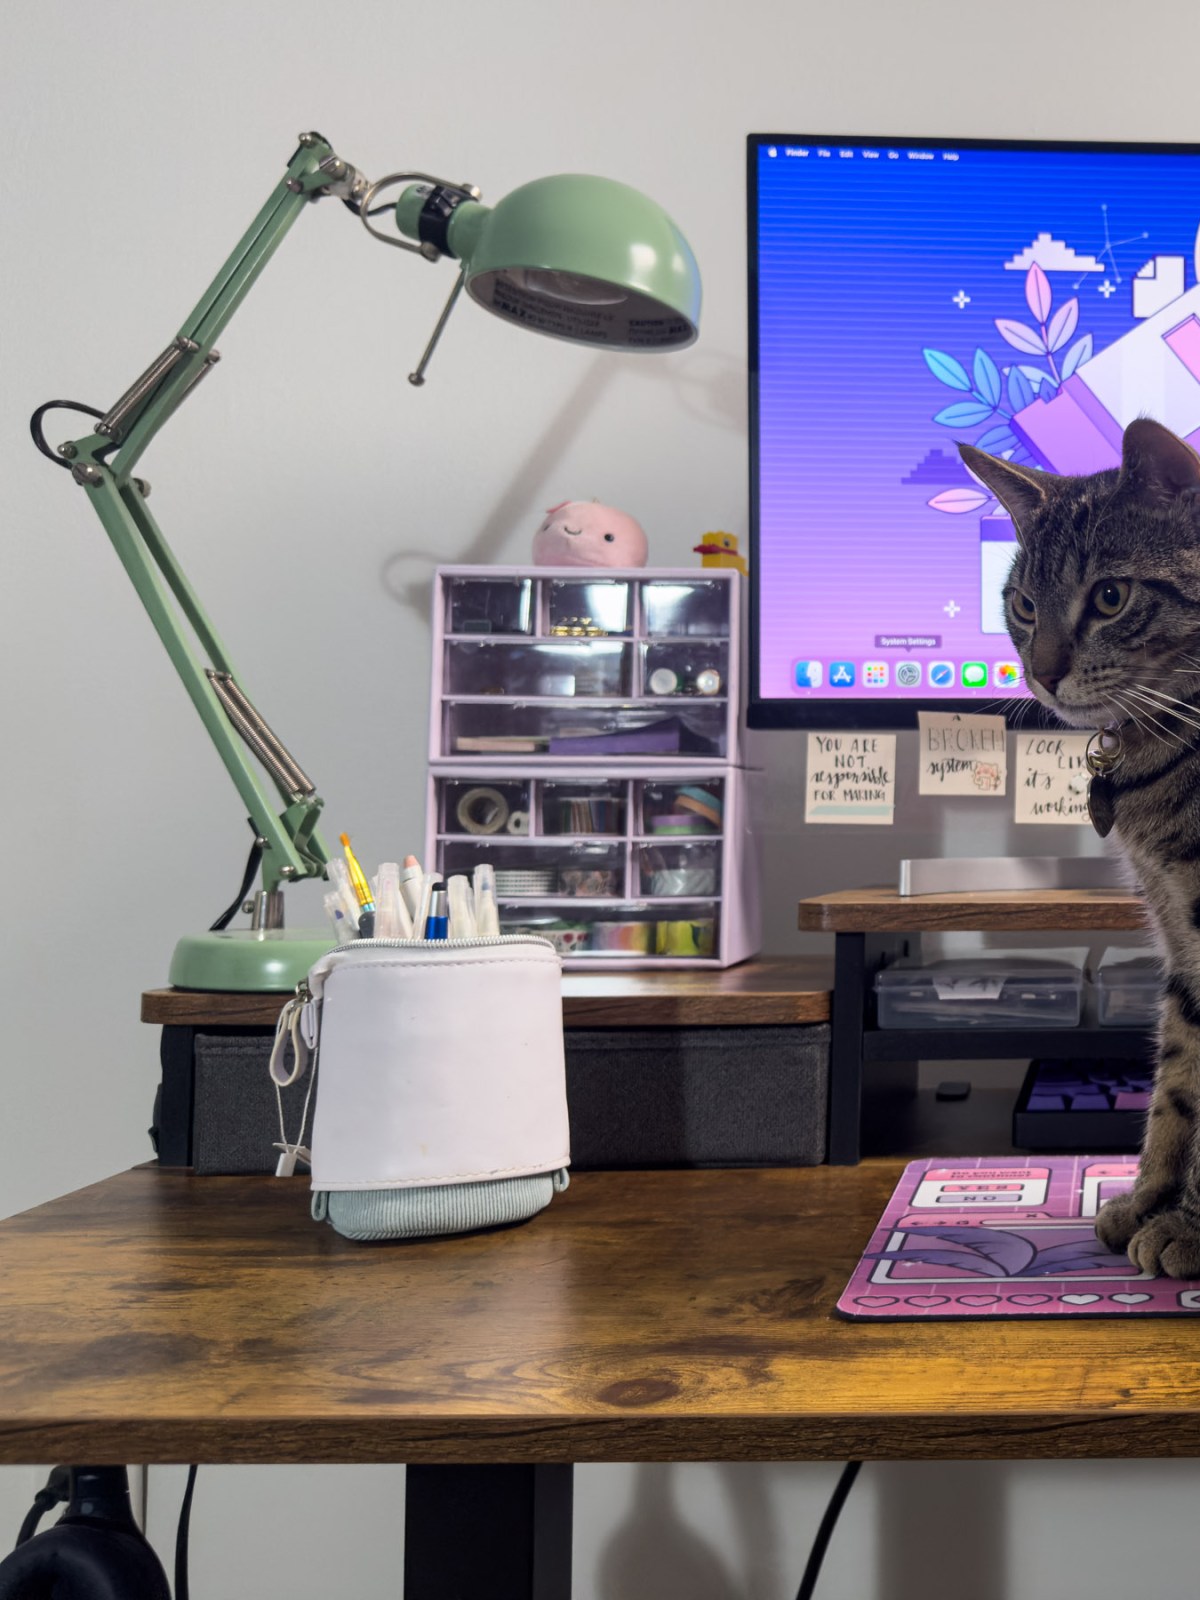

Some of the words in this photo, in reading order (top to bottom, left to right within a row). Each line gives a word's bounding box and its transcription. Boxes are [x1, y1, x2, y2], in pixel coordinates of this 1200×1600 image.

[785, 149, 809, 158] Finder
[817, 150, 831, 158] File
[839, 150, 853, 158] Edit
[862, 150, 879, 159] View
[888, 151, 899, 160] Go
[907, 151, 934, 160] Window
[942, 152, 959, 161] Help
[881, 636, 907, 647] System
[907, 637, 936, 647] Settings
[816, 736, 842, 754] YOU
[851, 738, 877, 753] ARE
[1026, 739, 1066, 756] LOOK
[834, 754, 866, 768] NOT
[811, 766, 892, 789] responsible
[926, 758, 976, 783] system
[814, 789, 835, 801] FOR
[843, 789, 886, 802] MAKING
